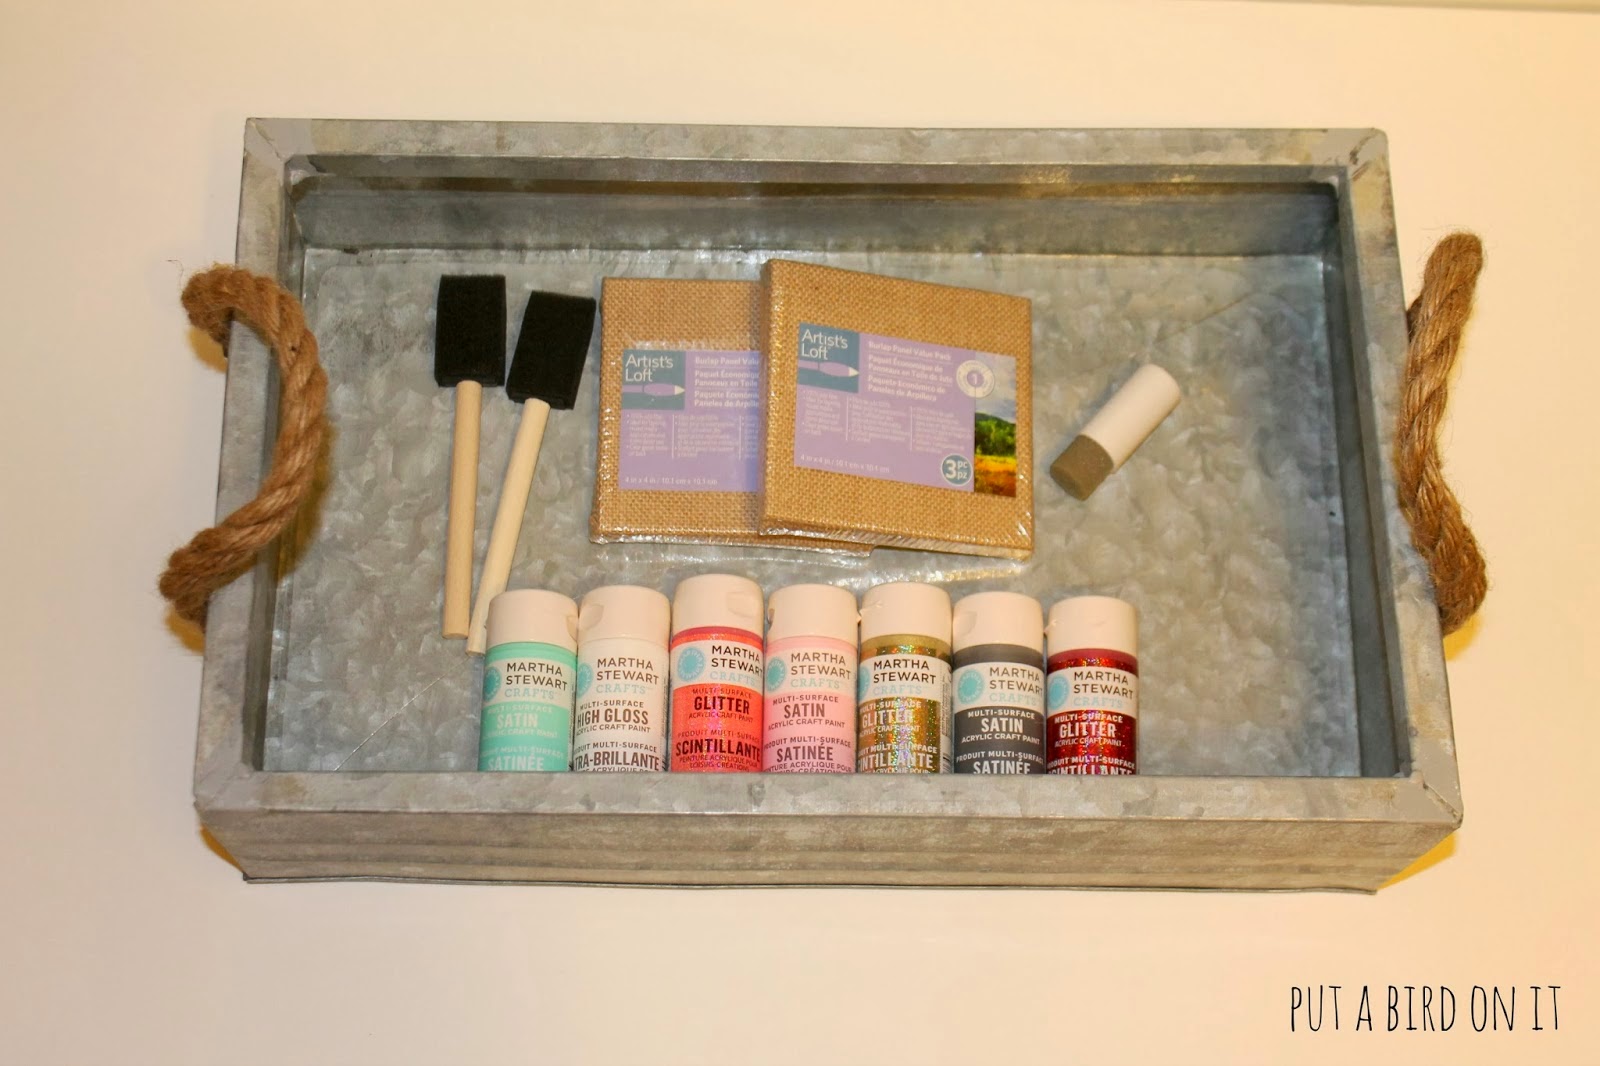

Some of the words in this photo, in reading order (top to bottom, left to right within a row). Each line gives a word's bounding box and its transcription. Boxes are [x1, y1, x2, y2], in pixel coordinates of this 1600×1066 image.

[801, 328, 848, 349] Artist's
[801, 343, 828, 360] Loft
[868, 340, 892, 352] Burlap
[893, 345, 912, 354] Panel
[914, 348, 934, 358] Value
[935, 351, 952, 361] Pack
[625, 353, 674, 369] Artist's
[695, 356, 719, 366] Burlap
[720, 356, 741, 365] Panel
[625, 368, 653, 382] Loft
[972, 373, 978, 385] 1
[945, 459, 957, 479] 3
[957, 460, 968, 471] pc
[957, 470, 968, 481] pz
[711, 645, 760, 664] MARTHA
[791, 652, 846, 666] MARTHA
[506, 662, 563, 677] MARTHA
[597, 657, 654, 671] MARTHA
[873, 659, 930, 671] MARTHA
[596, 670, 660, 686] STEWART
[791, 665, 851, 680] STEWART
[873, 672, 937, 685] STEWART
[989, 666, 1040, 682] MARTHA
[1074, 671, 1129, 685] MARTHA
[505, 674, 568, 691] STEWART
[595, 684, 646, 695] CRAFTS
[791, 679, 840, 690] CRAFTS
[504, 687, 555, 700] CRAFTS
[872, 684, 922, 696] CRAFTS
[1073, 683, 1134, 700] STEWART
[580, 699, 644, 711] MULTI-SURFACE
[694, 696, 750, 715] GLITTER
[772, 694, 839, 706] MULTI-SURFACE
[989, 692, 1037, 706] CRAFTS
[1073, 697, 1122, 709] CRAFTS
[783, 703, 826, 719] SATIN
[967, 709, 1036, 720] MULTI-SURFACE
[1054, 712, 1124, 724] MULTI-SURFACE
[496, 712, 538, 729] SATIN
[577, 708, 600, 729] HIGH
[604, 708, 649, 725] GLOSS
[768, 719, 794, 731] ACRYLIC
[825, 719, 845, 728] PAINT
[862, 709, 913, 729] GLITTER
[981, 717, 1024, 734] SATIN
[599, 723, 627, 731] CRAFT
[628, 724, 651, 733] PAINT
[1059, 721, 1116, 739] GLITTER
[790, 736, 851, 748] MULTI-SURFACE
[961, 733, 993, 744] ACRYLIC
[1022, 735, 1040, 745] PAINT
[592, 741, 657, 753] MULTI-SURFACE
[675, 738, 760, 762] SCINTILLANTE
[776, 742, 834, 763] SATINÉE
[956, 751, 986, 763] PRODUIT
[1071, 755, 1135, 769] MULTI-SURFACE
[790, 761, 835, 769] ACRYLIQUE
